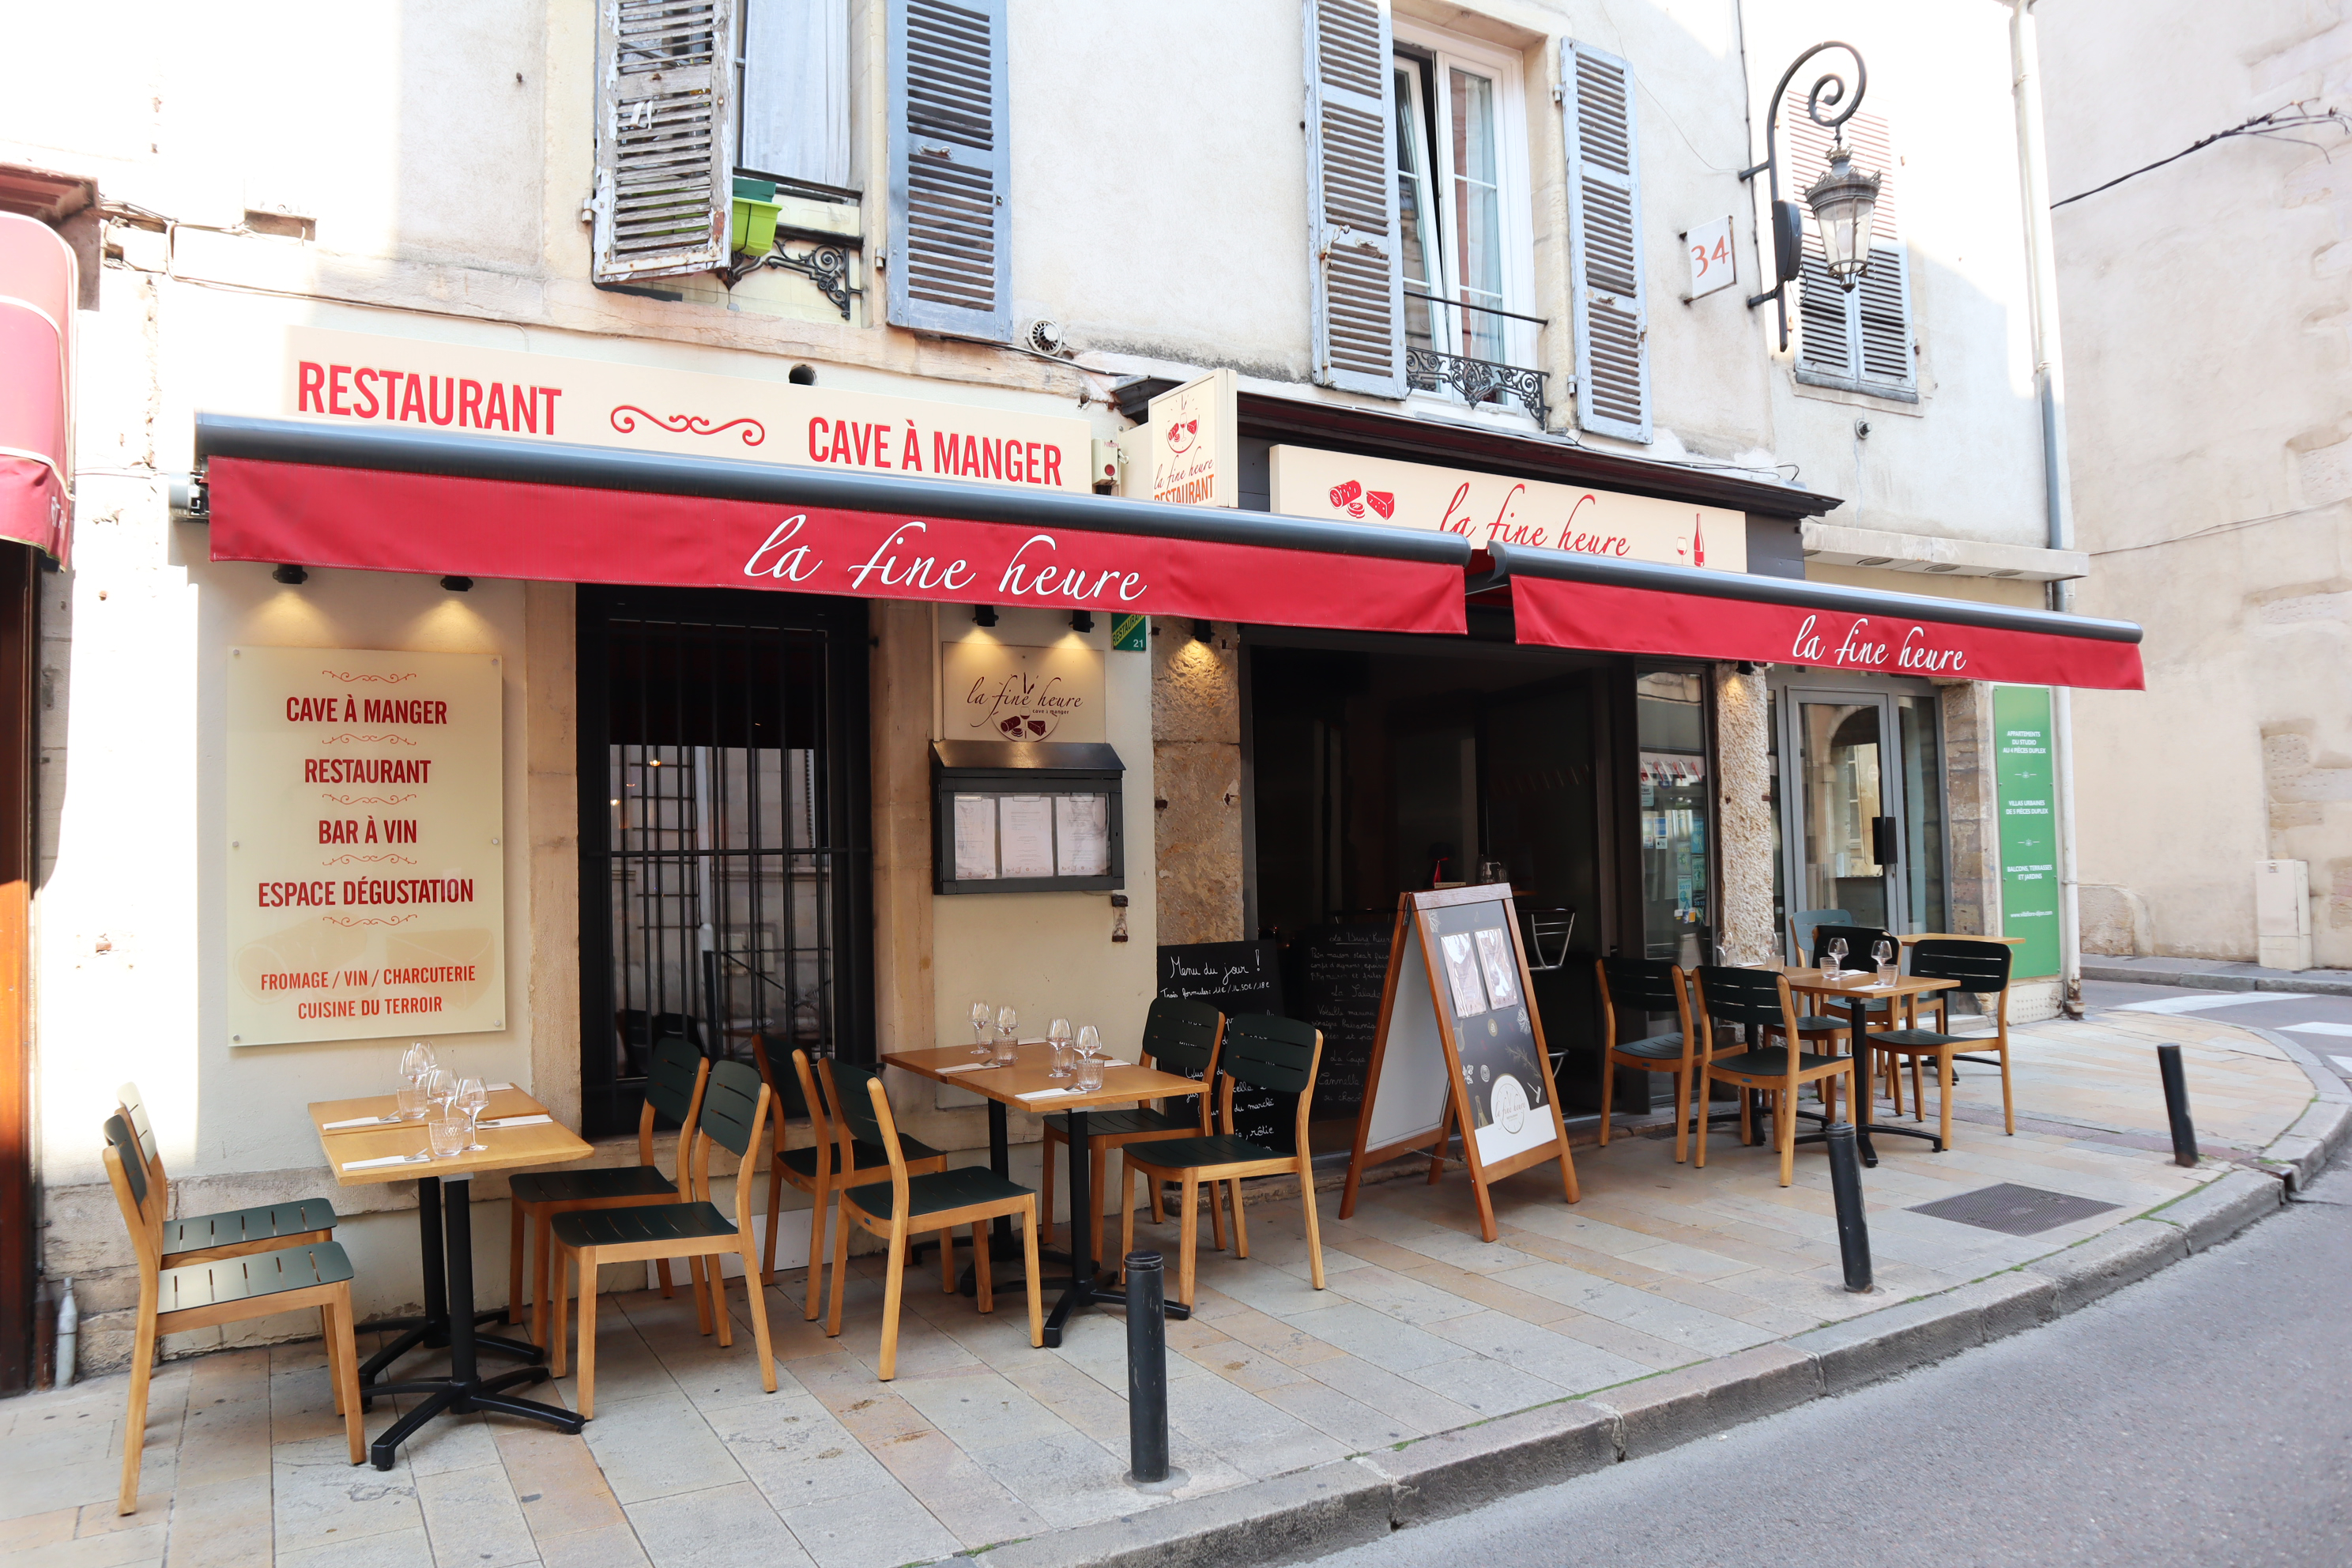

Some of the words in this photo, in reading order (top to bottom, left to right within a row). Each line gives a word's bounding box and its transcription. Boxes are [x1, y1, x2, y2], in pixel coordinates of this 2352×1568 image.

[1691, 235, 1729, 277] 34
[297, 360, 562, 435] RESTAURANT
[808, 416, 891, 469] CAVE
[901, 418, 922, 472] À
[933, 432, 1062, 486] MANGER
[1154, 463, 1165, 490] la
[1166, 454, 1186, 491] fine
[1189, 446, 1214, 477] heure
[1154, 473, 1215, 504] STAURANT
[1439, 482, 1476, 538] la
[1487, 484, 1547, 548] fine
[1558, 494, 1630, 556] heure
[744, 514, 824, 582] la
[847, 521, 976, 590] fine
[998, 534, 1148, 601] heure
[1133, 639, 1144, 648] 21
[1792, 615, 1826, 661] la
[1834, 618, 1889, 665] fine
[1898, 626, 1967, 671] heure
[967, 677, 989, 705] la
[970, 675, 1031, 728] fine
[1038, 677, 1084, 707] heure
[286, 696, 338, 722] CAVE
[344, 694, 358, 723] À
[364, 699, 448, 725] MANGER
[304, 758, 432, 784] RESTAURANT
[318, 820, 358, 845] BAR
[364, 815, 379, 844] À
[383, 820, 417, 844] VIN
[258, 881, 336, 908] ESPACE
[343, 876, 474, 906] DÉGUSTATION
[261, 971, 329, 991] FROMAGE
[344, 969, 368, 988] VIN
[383, 966, 476, 986] CHARCUTERIE
[1170, 956, 1201, 978] Menu
[1204, 962, 1218, 975] du
[1222, 963, 1249, 985] jour
[1160, 987, 1178, 998] Trois
[1331, 985, 1344, 997] La
[1351, 984, 1381, 998] Salade
[297, 1001, 356, 1020] CUISINE
[361, 999, 380, 1016] DU
[385, 996, 443, 1015] TERROIR
[1330, 1050, 1343, 1061] La
[1234, 1103, 1244, 1112] du
[1248, 1097, 1275, 1110] marché
[1250, 1125, 1275, 1137] rôtie
